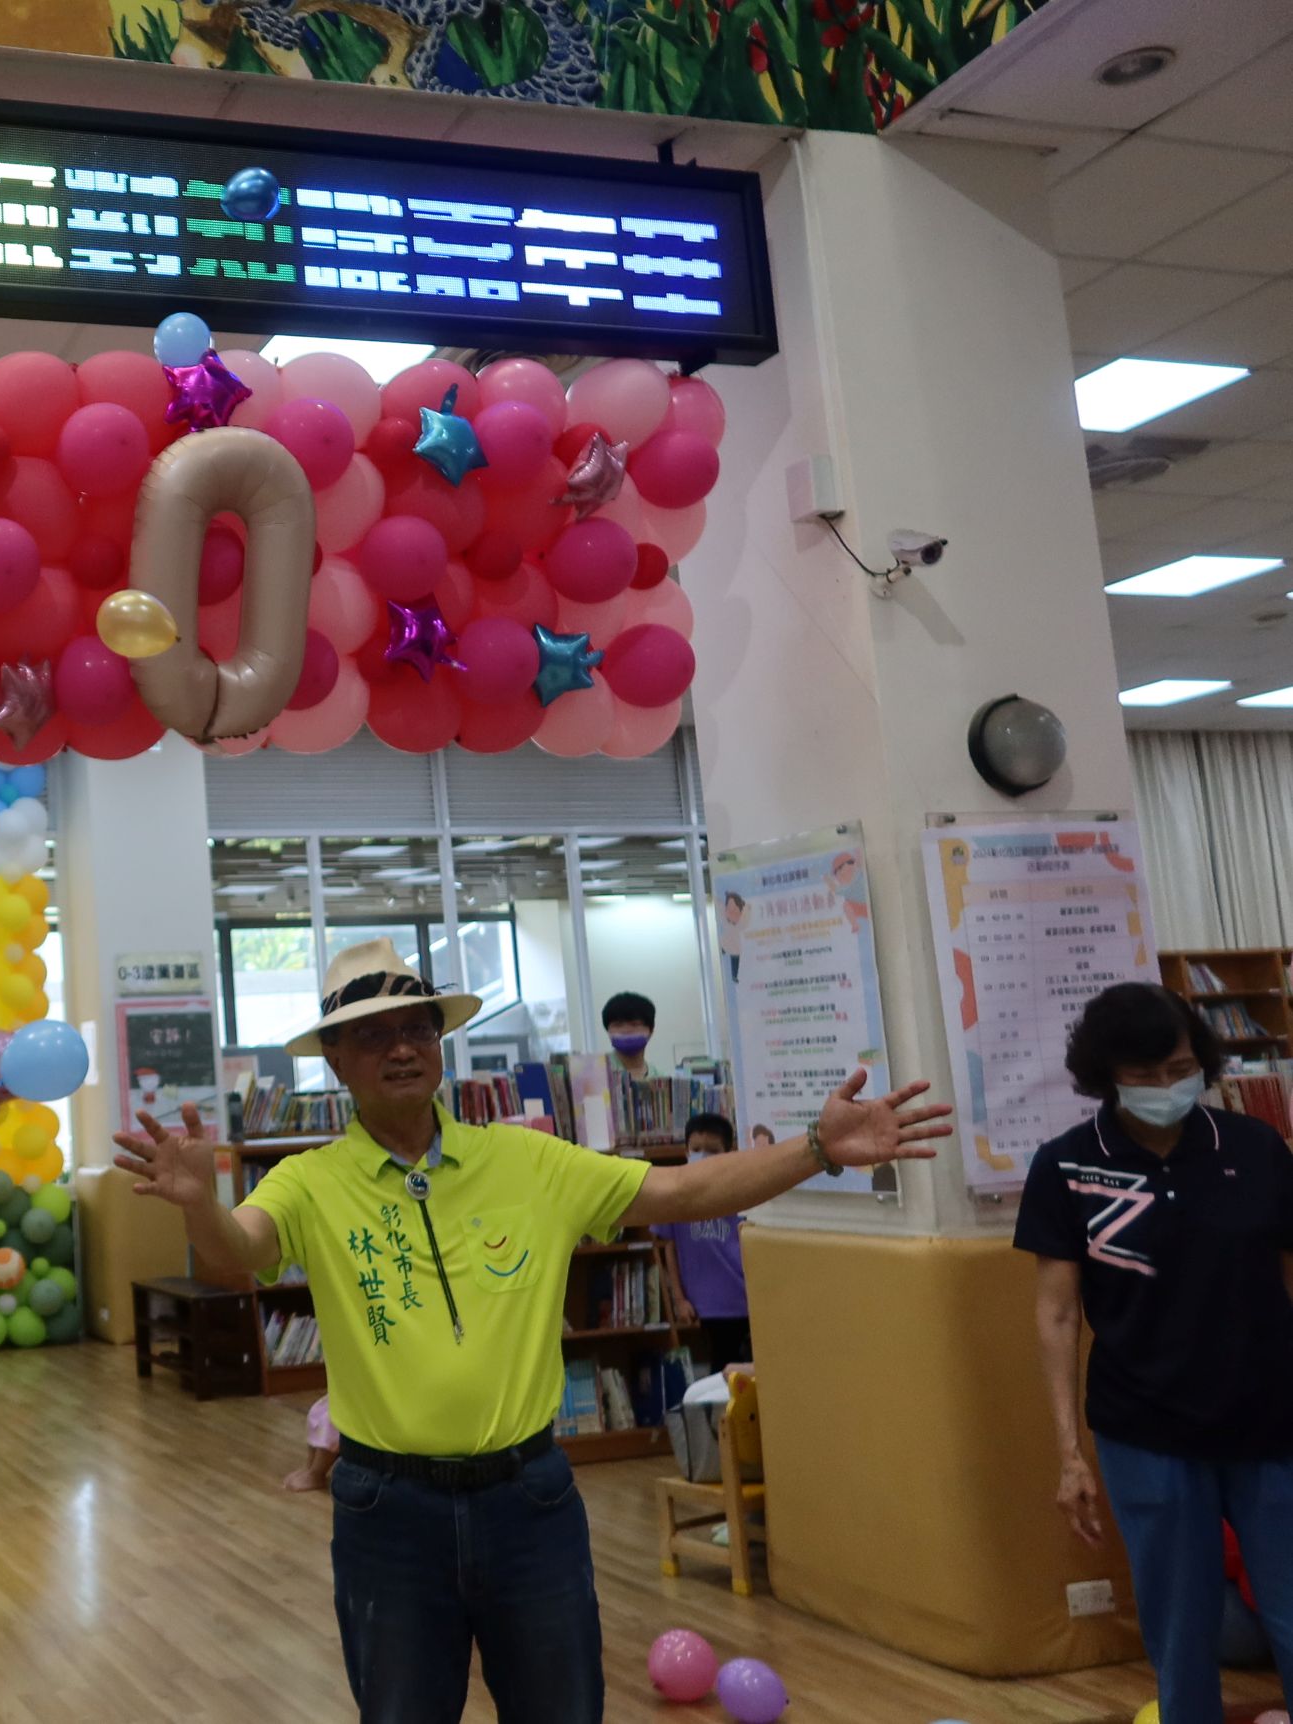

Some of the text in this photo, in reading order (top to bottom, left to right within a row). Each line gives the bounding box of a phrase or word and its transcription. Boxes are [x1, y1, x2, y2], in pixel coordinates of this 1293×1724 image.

[348, 1227, 396, 1346] 林世賢
[380, 1203, 424, 1311] 彰化市長
